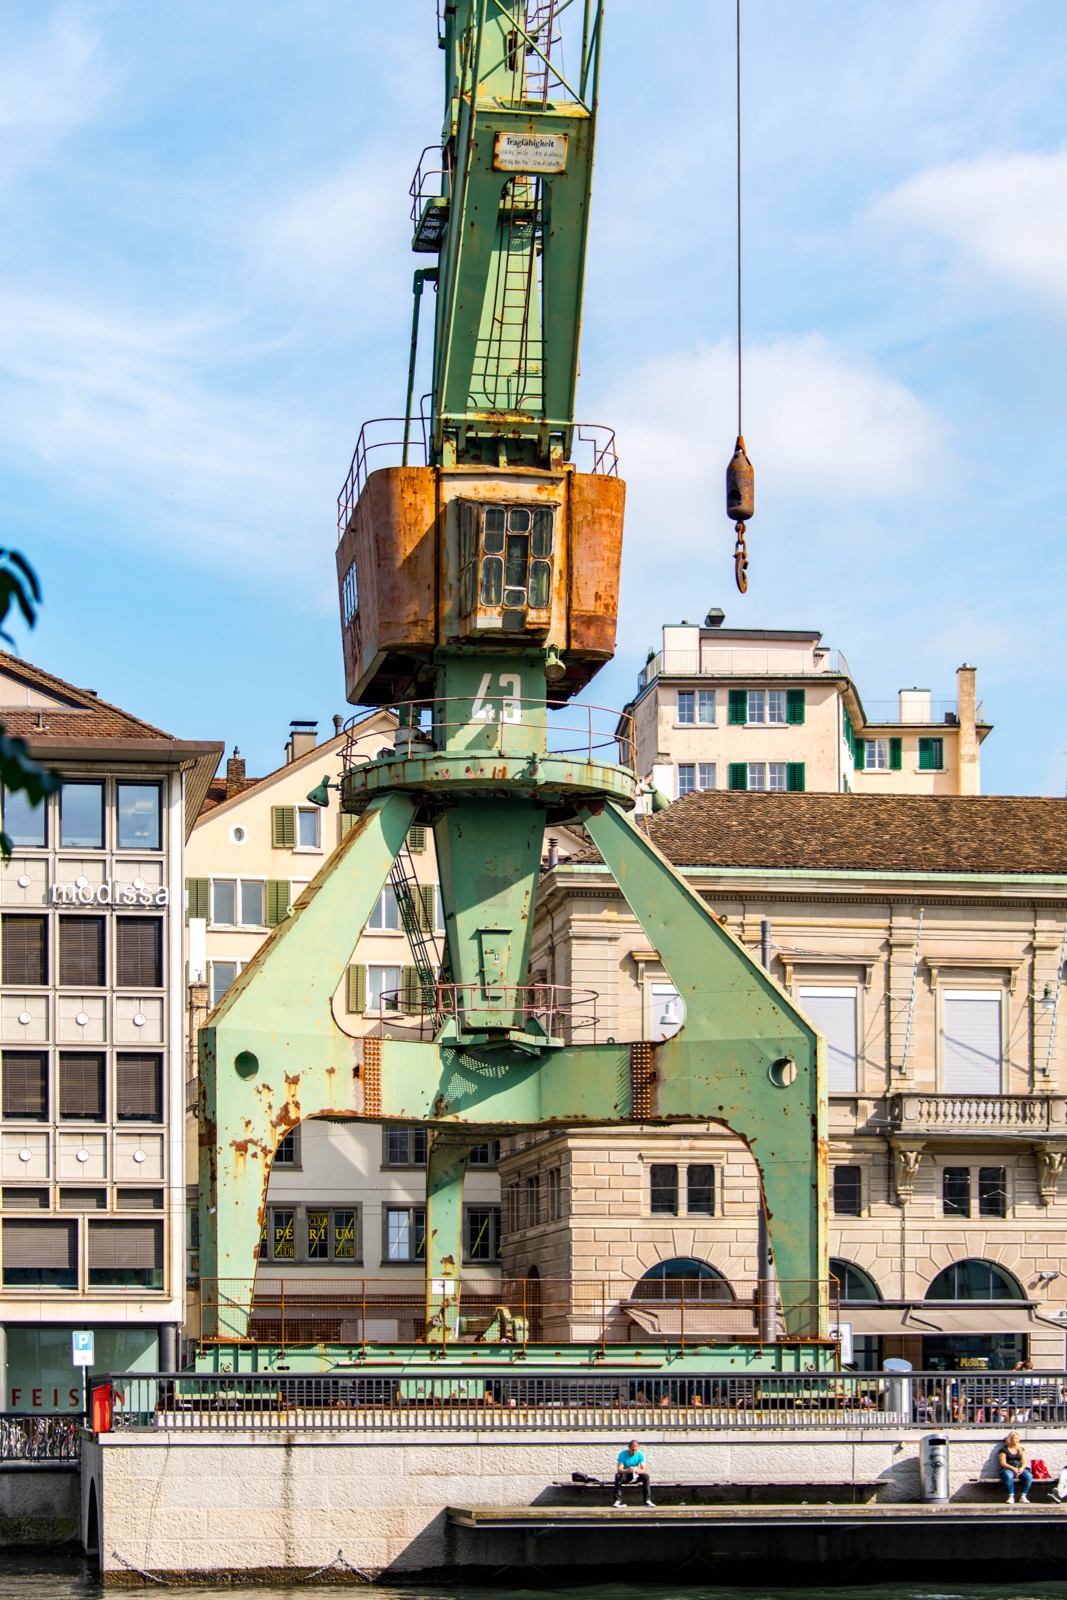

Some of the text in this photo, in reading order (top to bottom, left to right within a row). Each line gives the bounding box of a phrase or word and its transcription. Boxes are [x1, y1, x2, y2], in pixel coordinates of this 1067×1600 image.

[506, 137, 555, 149] Tragfähigkeit
[471, 673, 522, 725] 43
[52, 877, 169, 905] modissa
[308, 1217, 328, 1226] CLUB
[275, 1248, 295, 1257] CLUB
[335, 1248, 355, 1257] CLUB
[78, 1334, 89, 1350] P
[11, 1388, 126, 1407] FEISN
